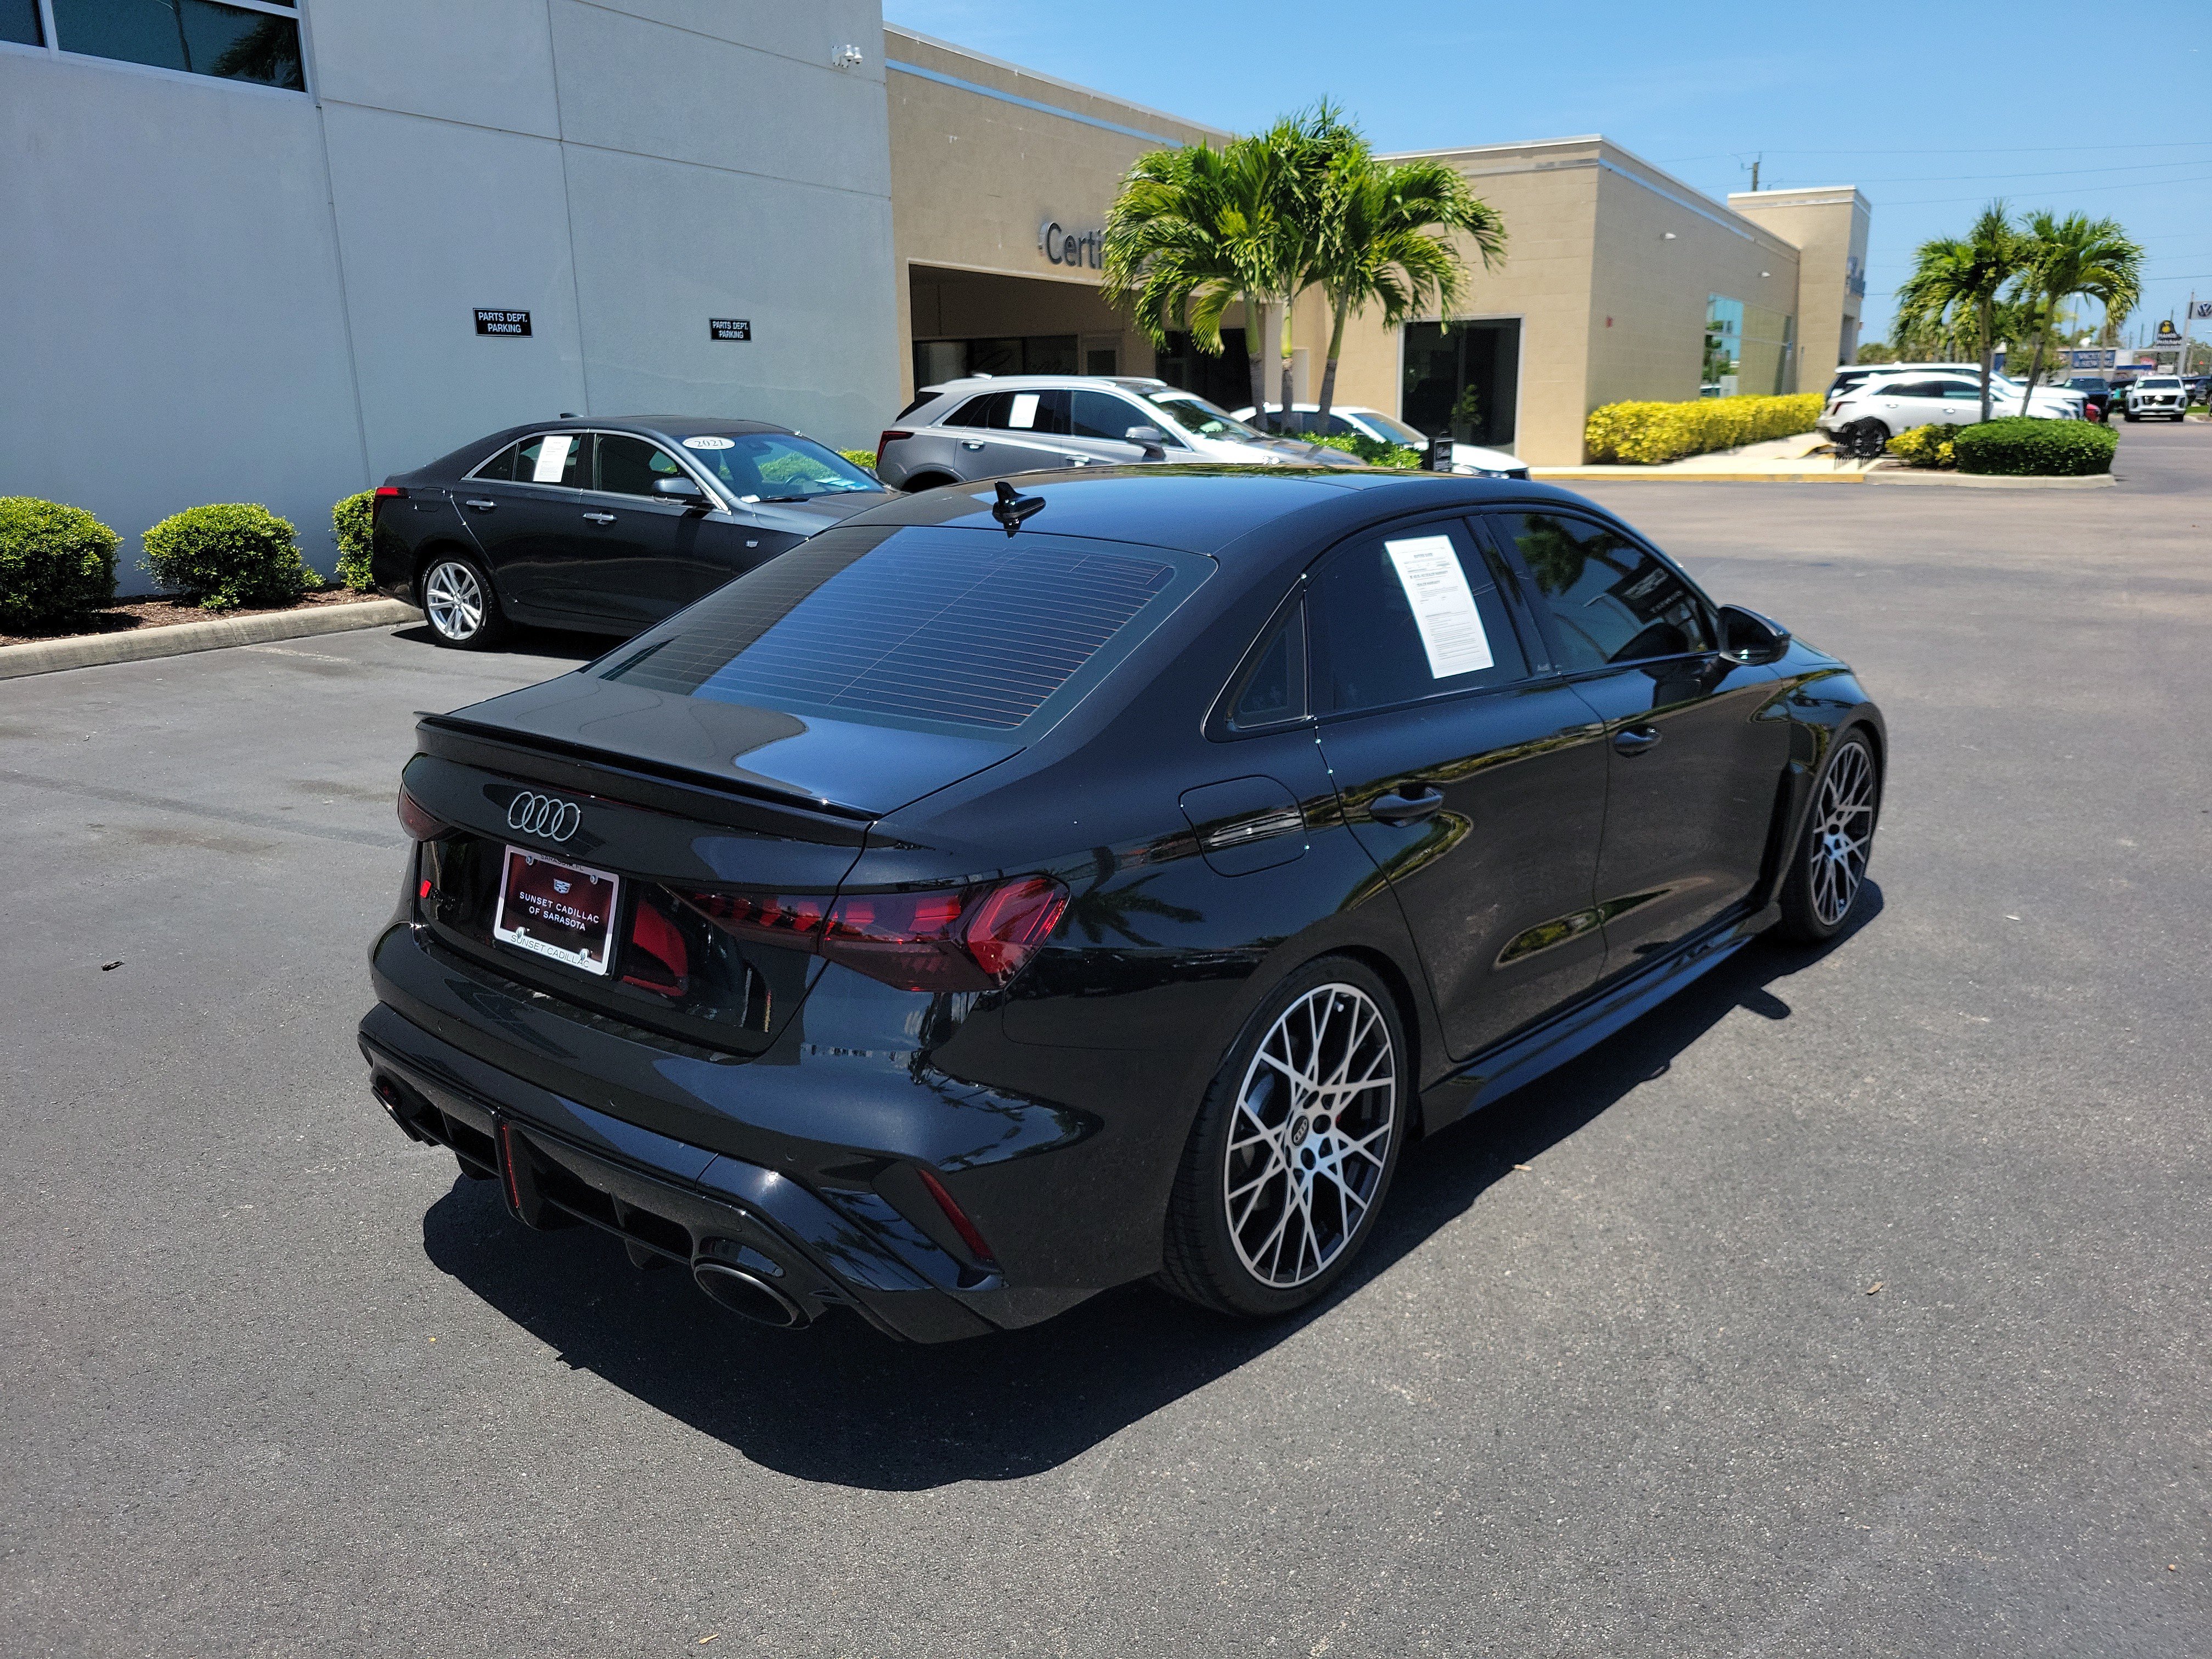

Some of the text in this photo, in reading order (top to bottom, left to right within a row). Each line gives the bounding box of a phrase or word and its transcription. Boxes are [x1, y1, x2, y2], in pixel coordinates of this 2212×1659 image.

[1046, 221, 1103, 269] Certi
[478, 312, 528, 323] PARTS DEPT.
[712, 320, 731, 329] PARTS
[487, 323, 522, 333] PARKING
[718, 330, 744, 338] PARKING
[519, 891, 600, 923] SUNSET CADILLAC
[528, 906, 586, 932] OF SARASOTA
[510, 934, 590, 968] SUNSET CADILLAC
